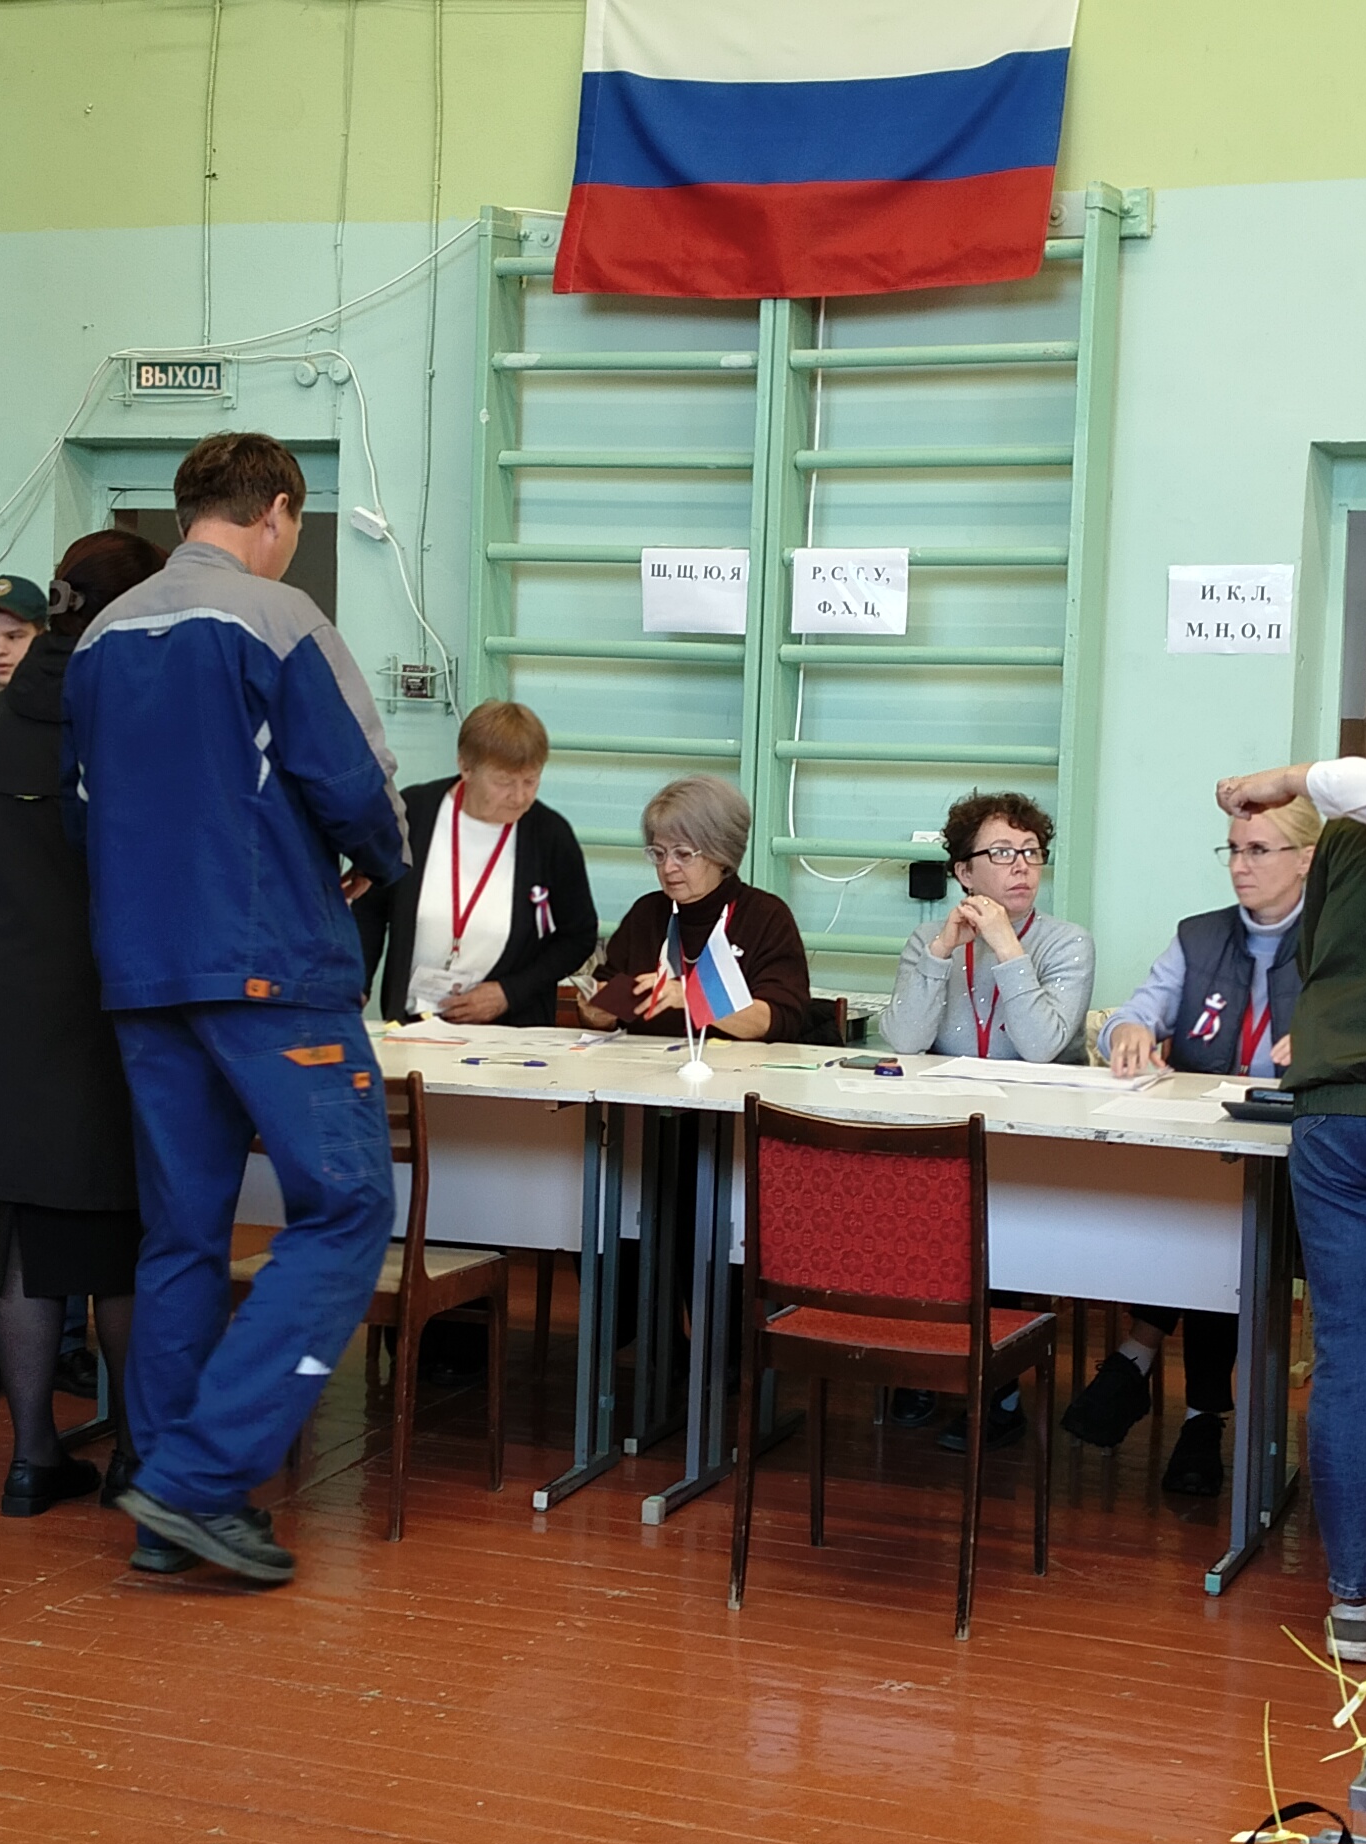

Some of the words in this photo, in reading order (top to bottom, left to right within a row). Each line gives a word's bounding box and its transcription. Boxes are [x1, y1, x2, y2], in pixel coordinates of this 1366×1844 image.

[140, 366, 218, 388] ВЫХОД
[650, 563, 672, 580] Ш,
[677, 565, 698, 581] Щ,
[703, 566, 725, 581] Ю,
[729, 567, 741, 580] Я
[812, 566, 826, 583] Р,
[831, 566, 847, 583] С,
[874, 567, 891, 584] У,
[1201, 585, 1220, 603] И,
[1227, 585, 1246, 604] К,
[1251, 585, 1271, 604] Л,
[817, 600, 836, 617] Ф,
[840, 601, 857, 617] Х,
[863, 601, 880, 618] Ц,
[1186, 622, 1209, 640] М,
[1215, 623, 1235, 641] Н,
[1241, 623, 1261, 641] О,
[1267, 623, 1282, 639] П
